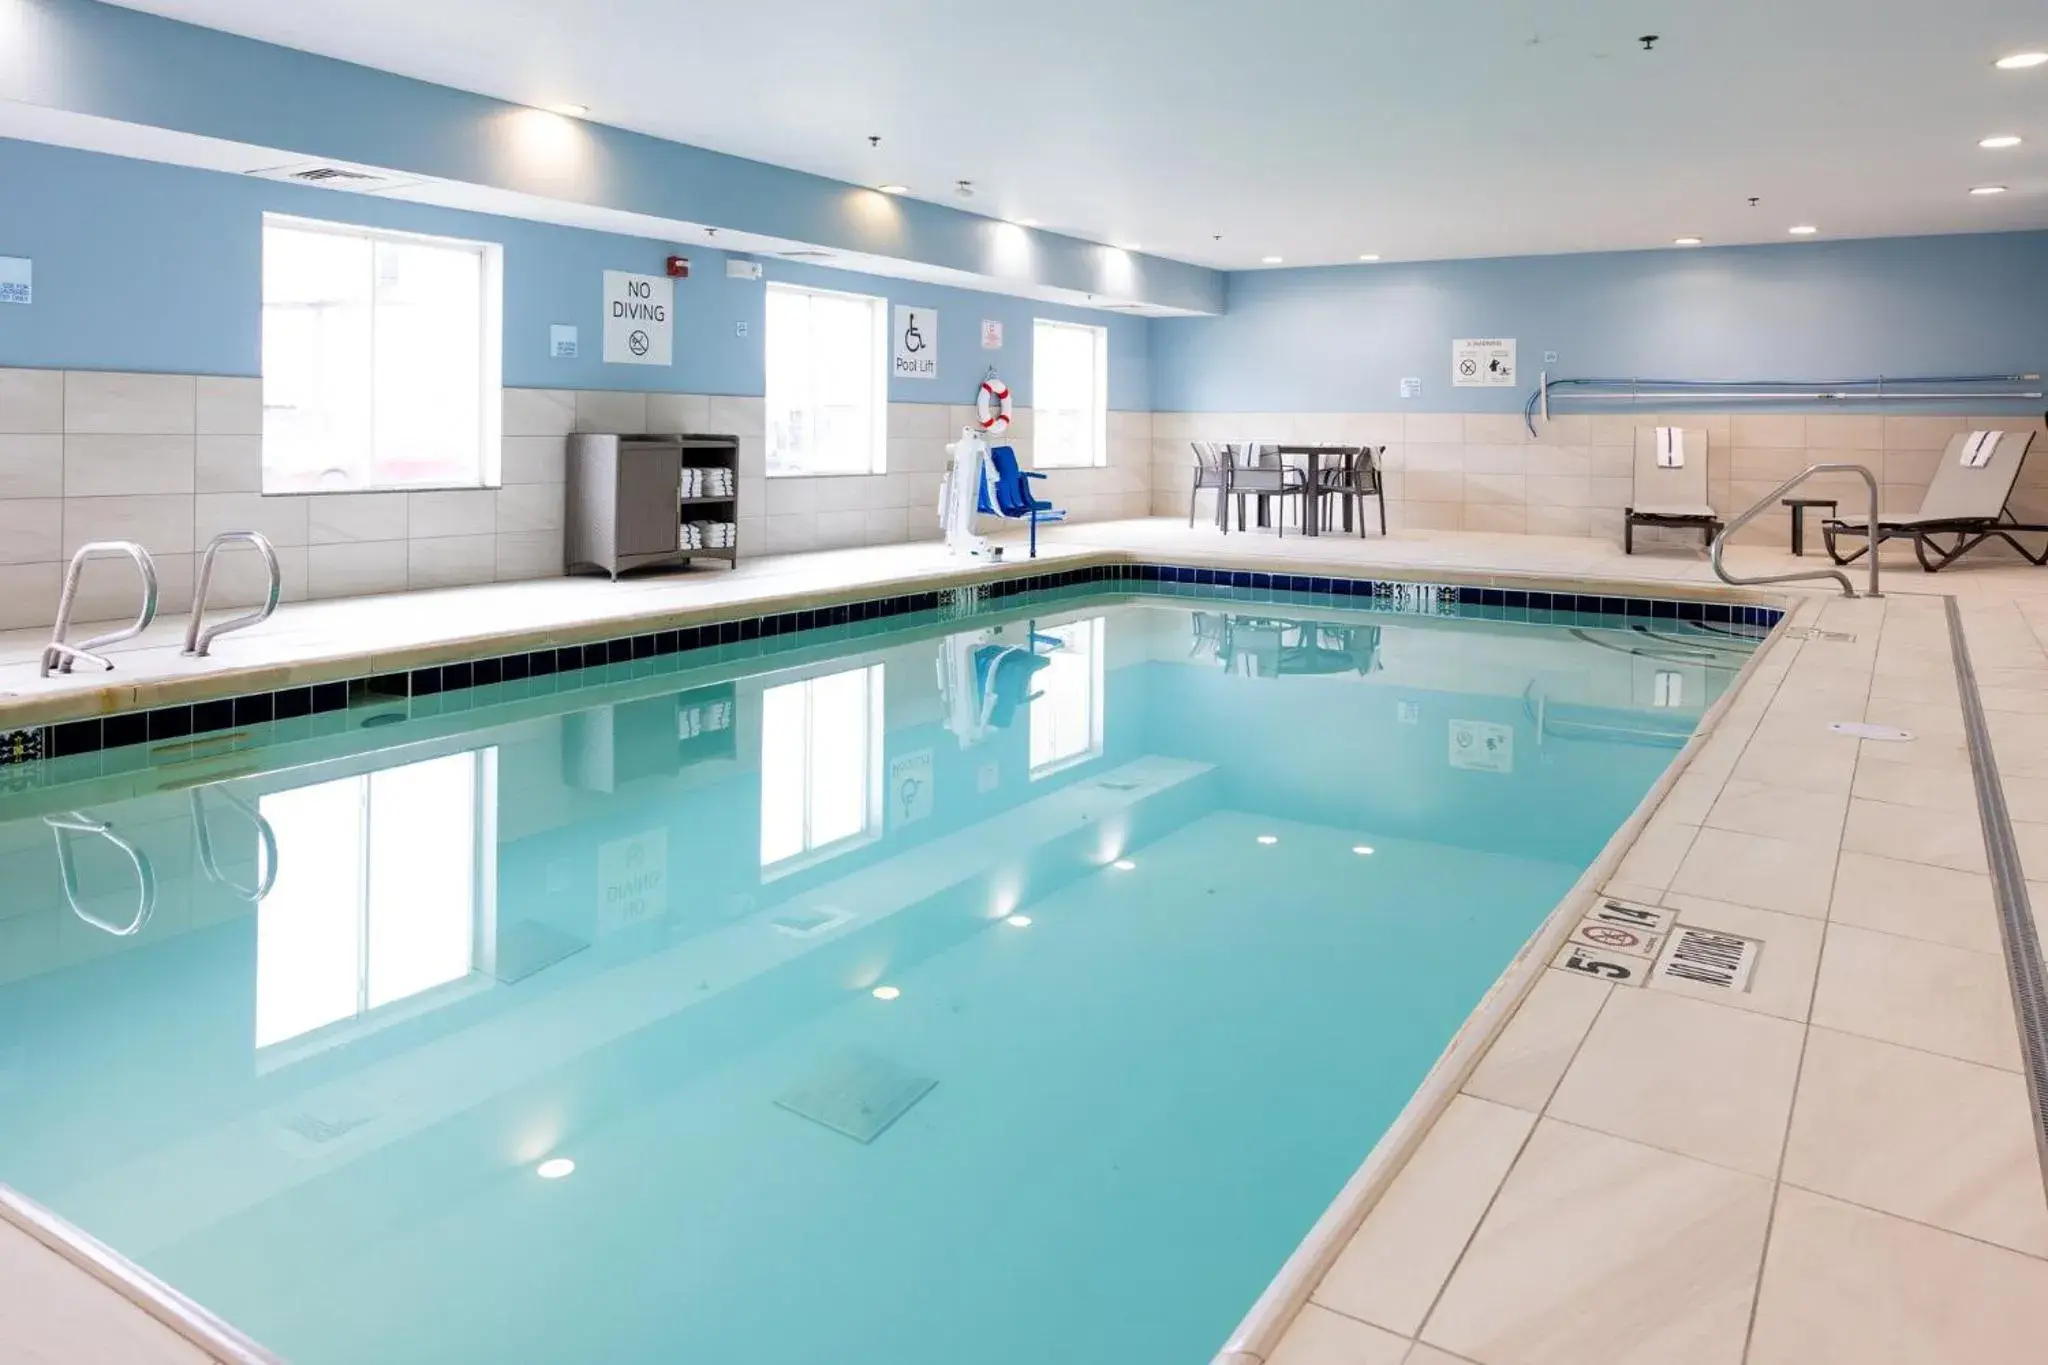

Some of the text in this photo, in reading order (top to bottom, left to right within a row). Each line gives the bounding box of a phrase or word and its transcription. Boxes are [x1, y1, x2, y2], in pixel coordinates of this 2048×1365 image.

[628, 281, 651, 299] NO
[613, 300, 665, 322] DIVING
[896, 357, 934, 373] Pool Lift
[1565, 956, 1631, 979] 5
[1665, 931, 1745, 988] NO DIVING
